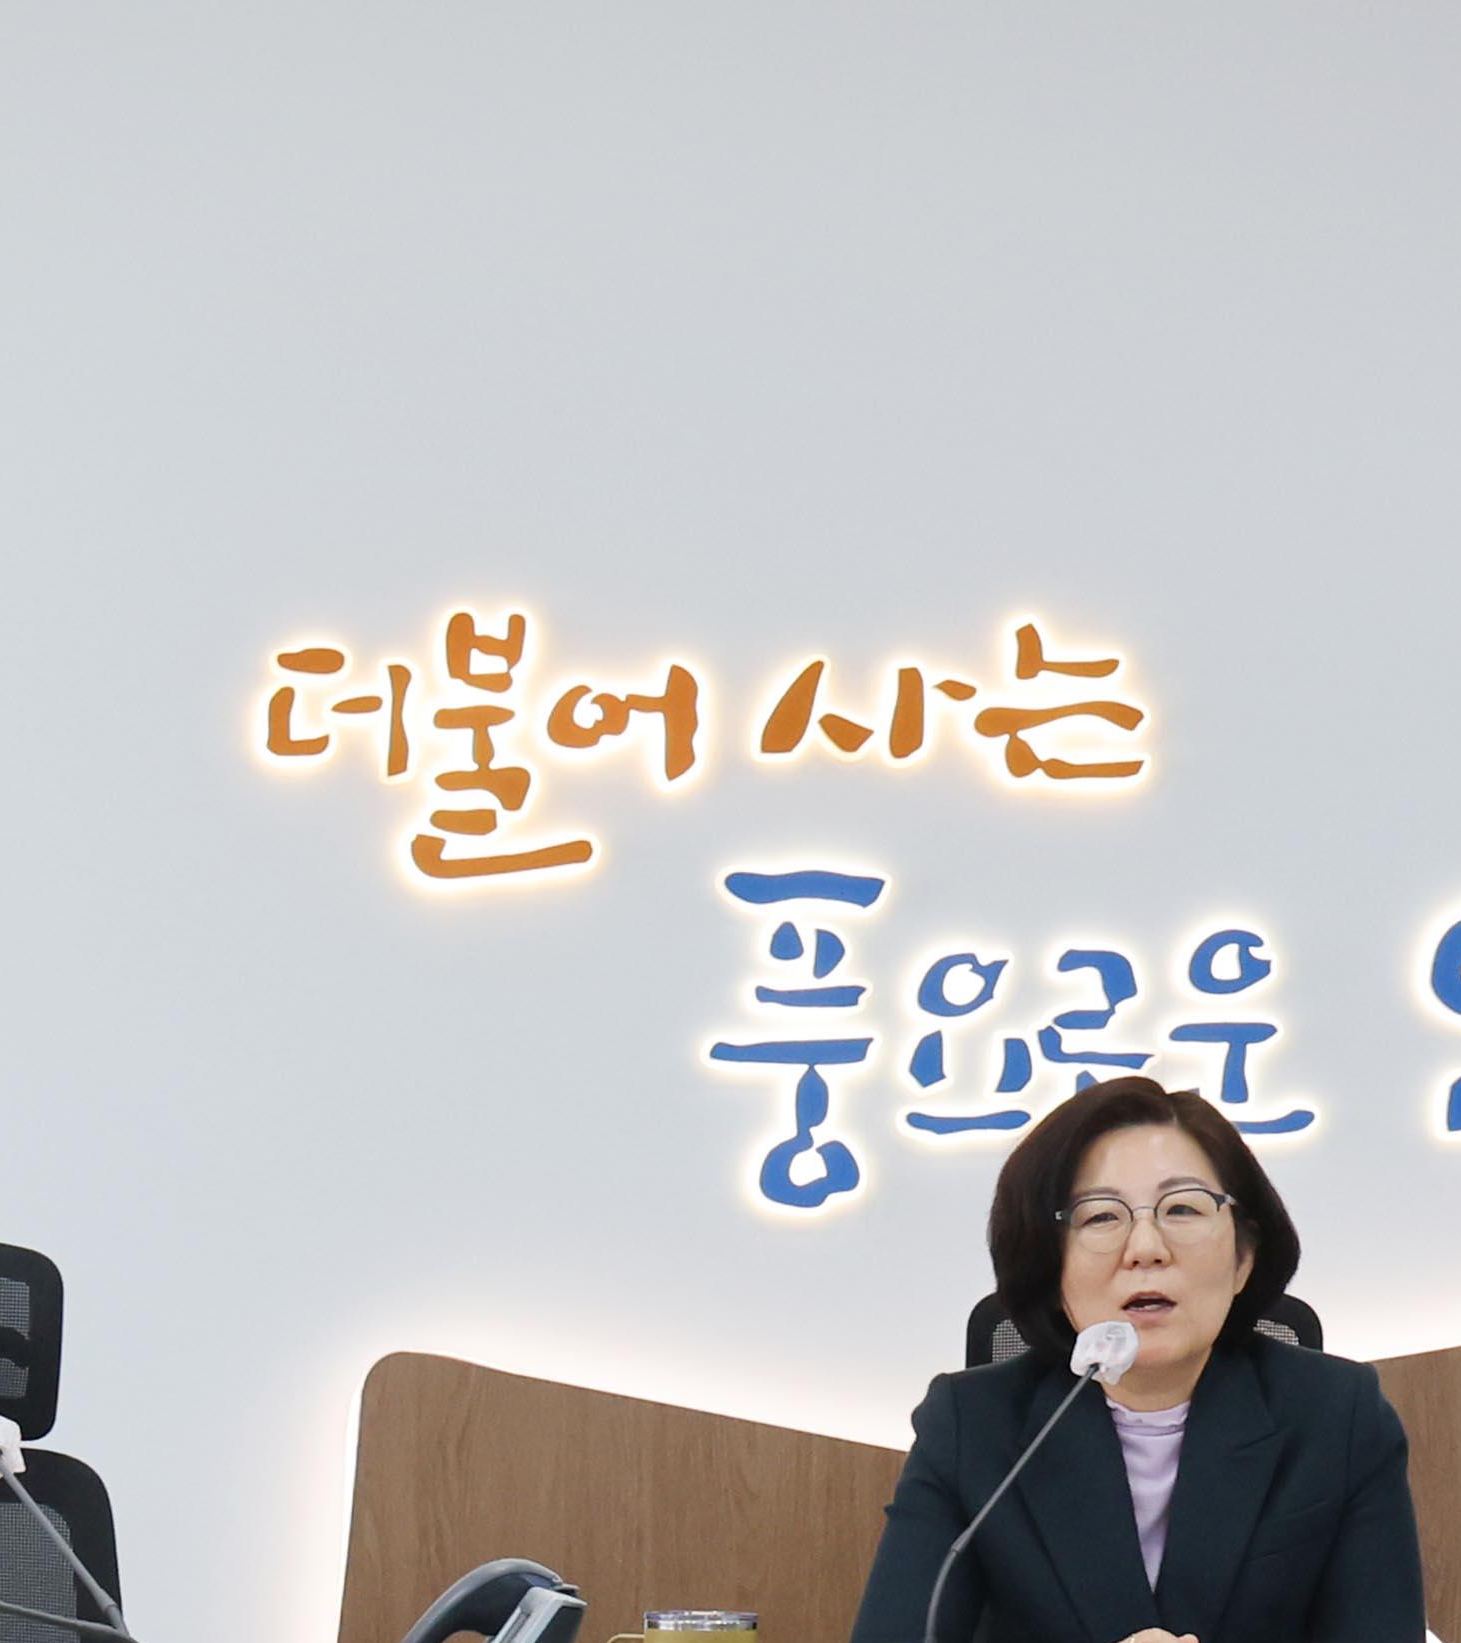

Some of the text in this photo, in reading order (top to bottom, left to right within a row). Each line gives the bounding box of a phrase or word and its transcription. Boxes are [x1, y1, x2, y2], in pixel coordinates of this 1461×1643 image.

[267, 612, 1145, 879] 더불어 사는
[709, 871, 1316, 1208] 풍요로운
